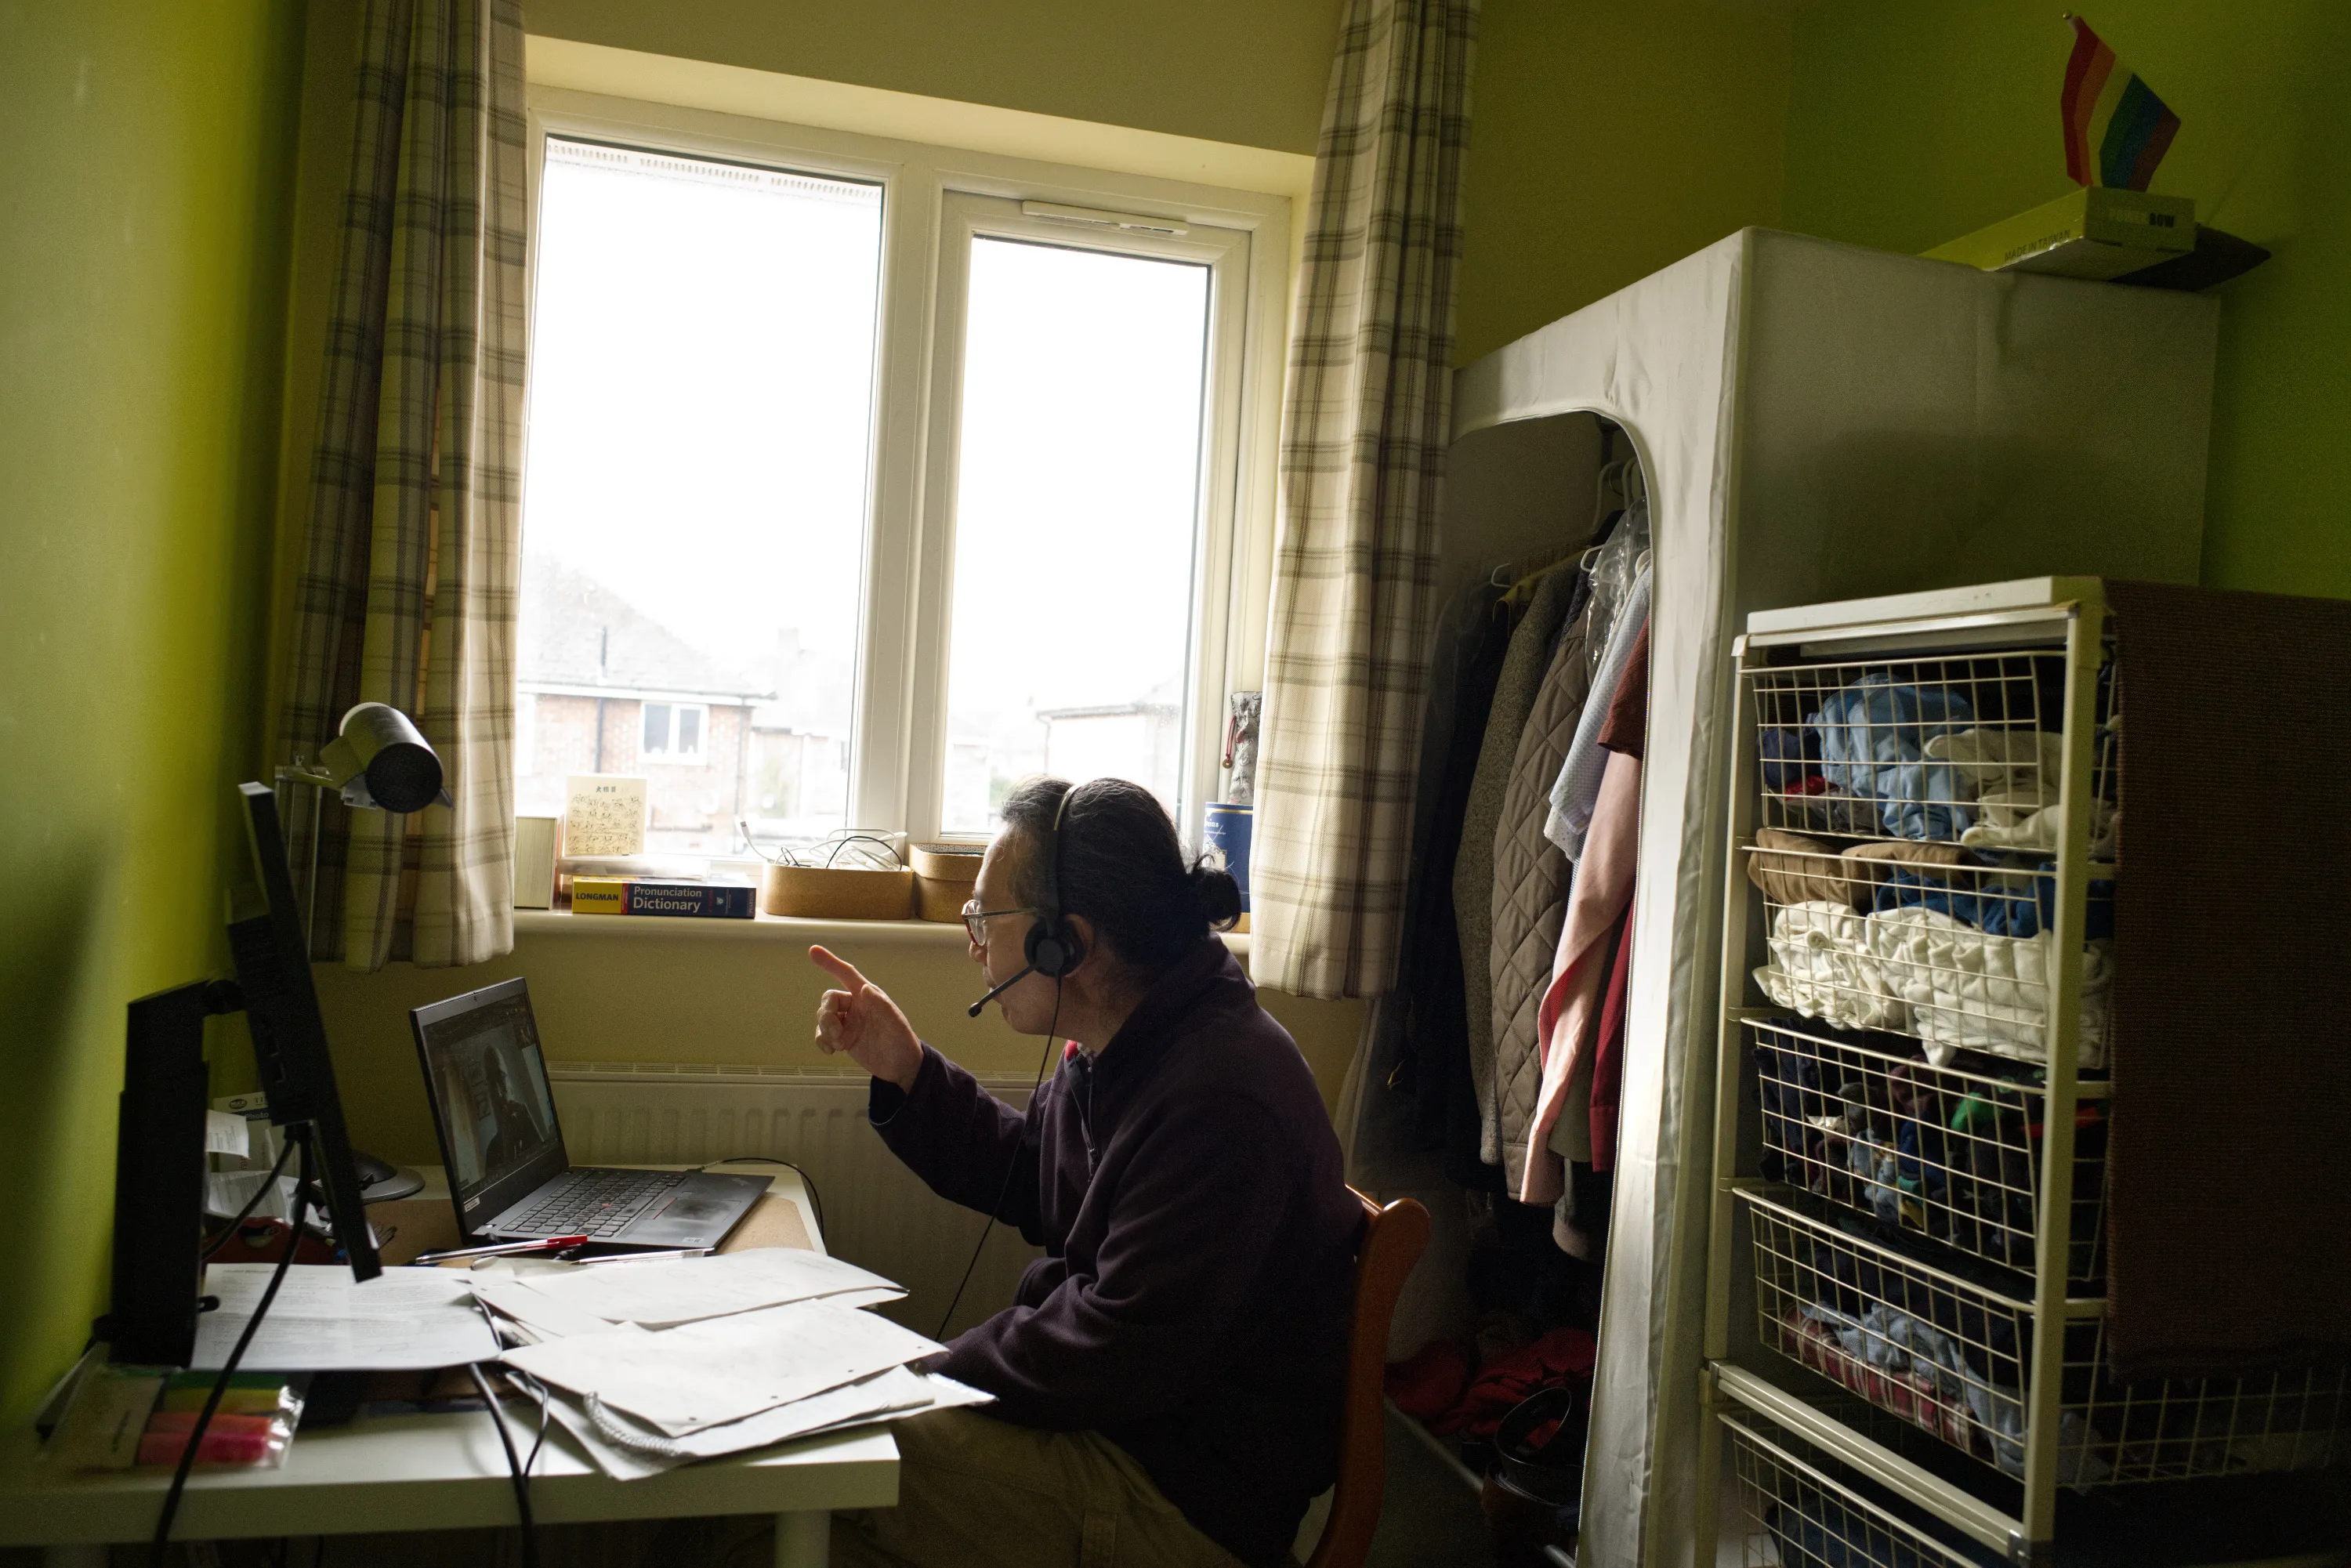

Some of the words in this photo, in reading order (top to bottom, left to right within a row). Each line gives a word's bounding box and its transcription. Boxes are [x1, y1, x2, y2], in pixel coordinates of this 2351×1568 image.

[2004, 244, 2027, 262] MADE
[2027, 241, 2038, 253] IN
[2038, 229, 2071, 248] TAIWAN
[576, 893, 619, 901] LONGMAN
[634, 885, 702, 897] Pronunciation
[633, 896, 701, 914] Dictionary
